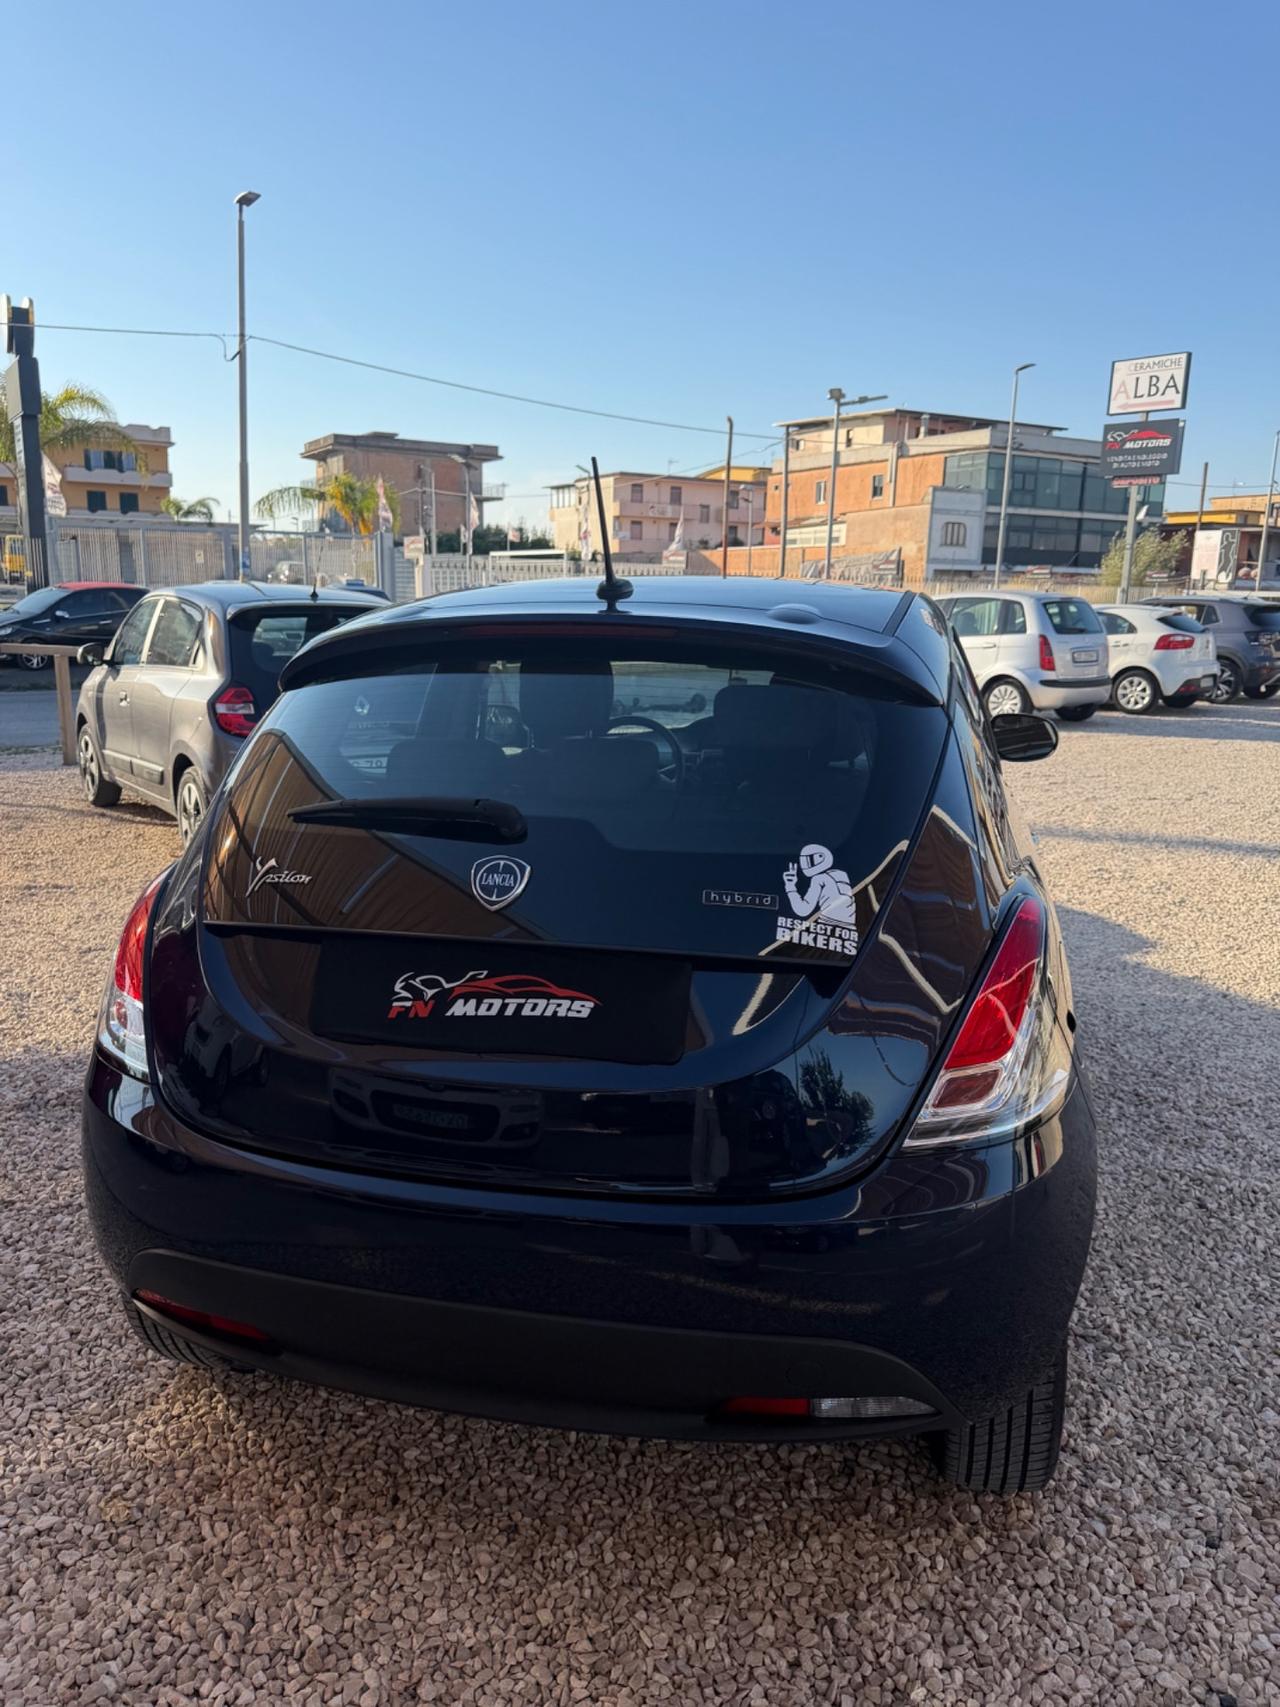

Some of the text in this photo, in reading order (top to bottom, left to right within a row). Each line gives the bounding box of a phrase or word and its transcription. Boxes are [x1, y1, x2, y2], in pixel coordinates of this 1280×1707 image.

[1128, 357, 1183, 372] CERAMICHE
[1113, 373, 1180, 400] ALBA
[1123, 438, 1172, 449] MOTORS
[245, 856, 313, 897] Ypsilon
[480, 872, 515, 888] LANCIA
[710, 892, 772, 906] hybrid
[777, 916, 859, 943] RESPECT FOR
[775, 926, 858, 957] BIKERS
[387, 998, 595, 1019] FN MOTORS
